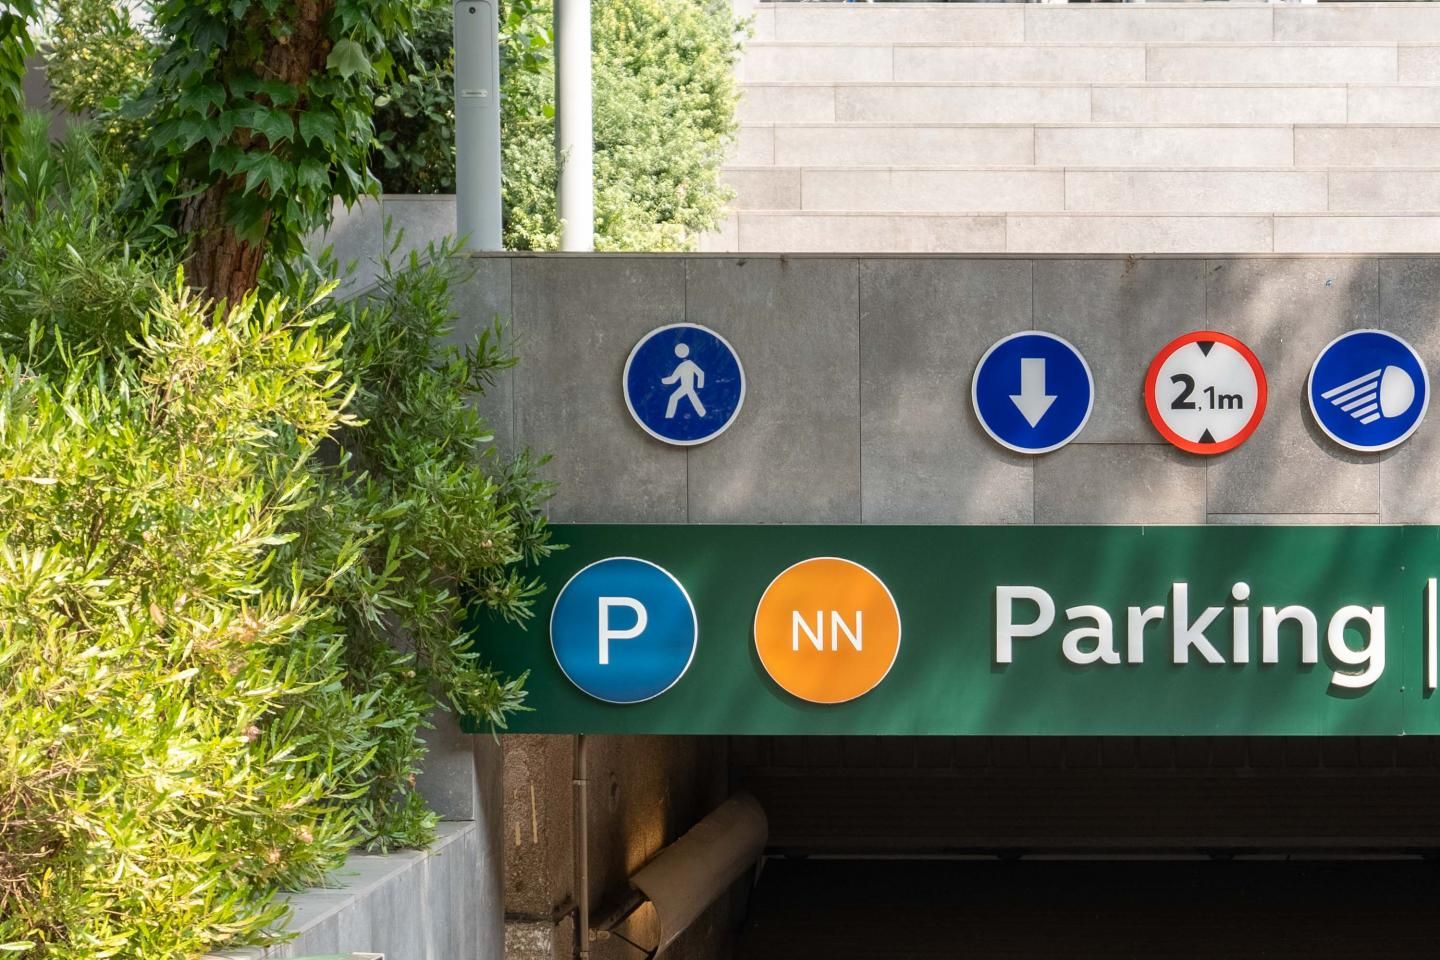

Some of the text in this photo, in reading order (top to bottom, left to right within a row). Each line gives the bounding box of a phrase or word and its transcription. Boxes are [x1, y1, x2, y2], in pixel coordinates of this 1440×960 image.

[1170, 373, 1243, 411] 2,1m
[598, 597, 648, 665] P
[792, 610, 863, 652] NN
[995, 582, 1386, 689] Parking
